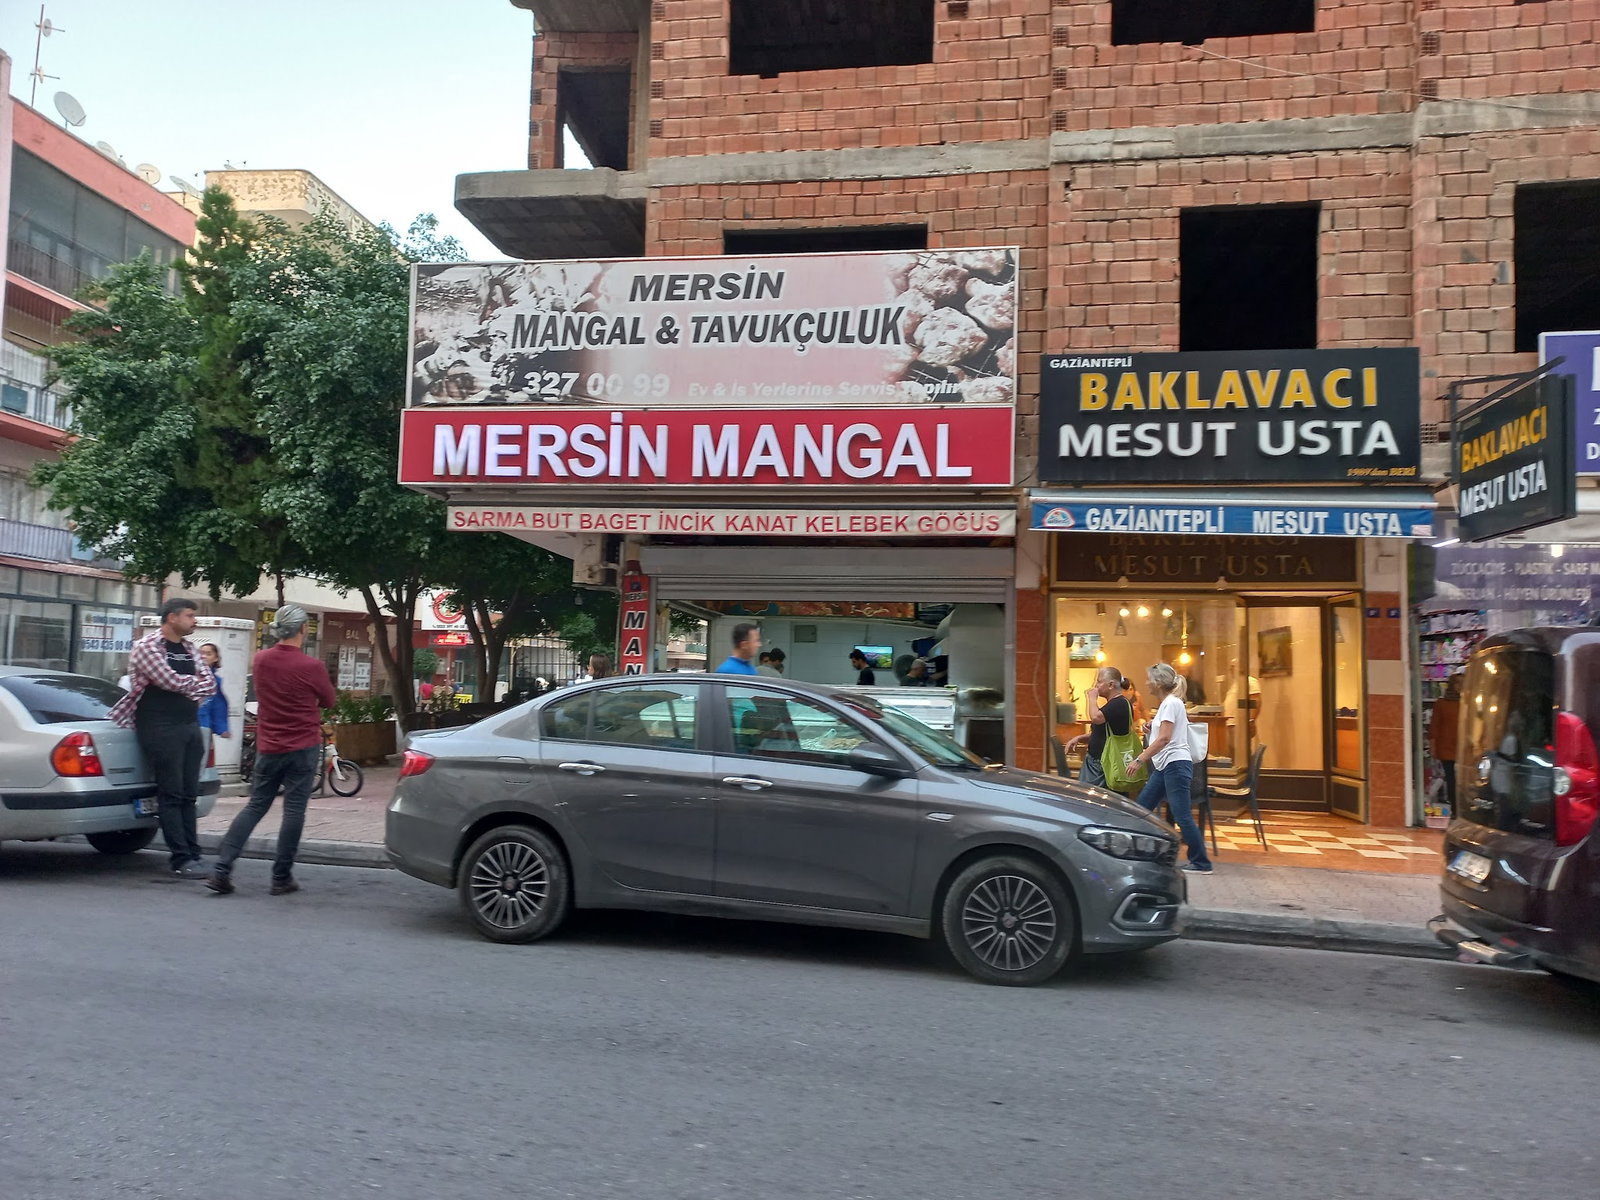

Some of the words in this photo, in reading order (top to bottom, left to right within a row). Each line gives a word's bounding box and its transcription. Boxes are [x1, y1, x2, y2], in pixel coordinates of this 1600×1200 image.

[629, 265, 784, 302] MERSİN
[511, 313, 646, 349] MANGAL
[656, 315, 679, 345] &
[691, 306, 906, 351] TAVUKÇULUK
[1050, 355, 1133, 369] GAZİANTEPLİ
[522, 371, 579, 396] 327
[586, 373, 624, 396] 00
[633, 373, 670, 397] 99
[688, 383, 708, 396] Ev
[713, 382, 726, 396] &
[752, 380, 834, 396] Yerlerine
[838, 381, 895, 396] Servis
[1079, 367, 1378, 411] BAKLAVACI
[433, 411, 669, 478] MERSİN
[691, 423, 973, 478] MANGAL
[1058, 421, 1236, 458] MESUT
[1258, 420, 1401, 456] USTA
[1461, 405, 1548, 473] BAKLAVACI
[1460, 475, 1506, 518] MESUT
[1508, 460, 1548, 502] USTA
[454, 511, 528, 529] SARMA
[533, 512, 573, 529] BUT
[579, 513, 651, 531] BAGET
[659, 510, 715, 531] İNCİK
[725, 515, 798, 532] KANAT
[806, 515, 909, 532] KELEBEK
[917, 512, 1000, 532] GÖĞÜS
[1085, 505, 1225, 533] GAZİANTEPLİ
[1252, 510, 1329, 534] MESUT
[1343, 511, 1403, 536] USTA
[1095, 555, 1207, 576] MESUT
[1227, 555, 1315, 576] USTA
